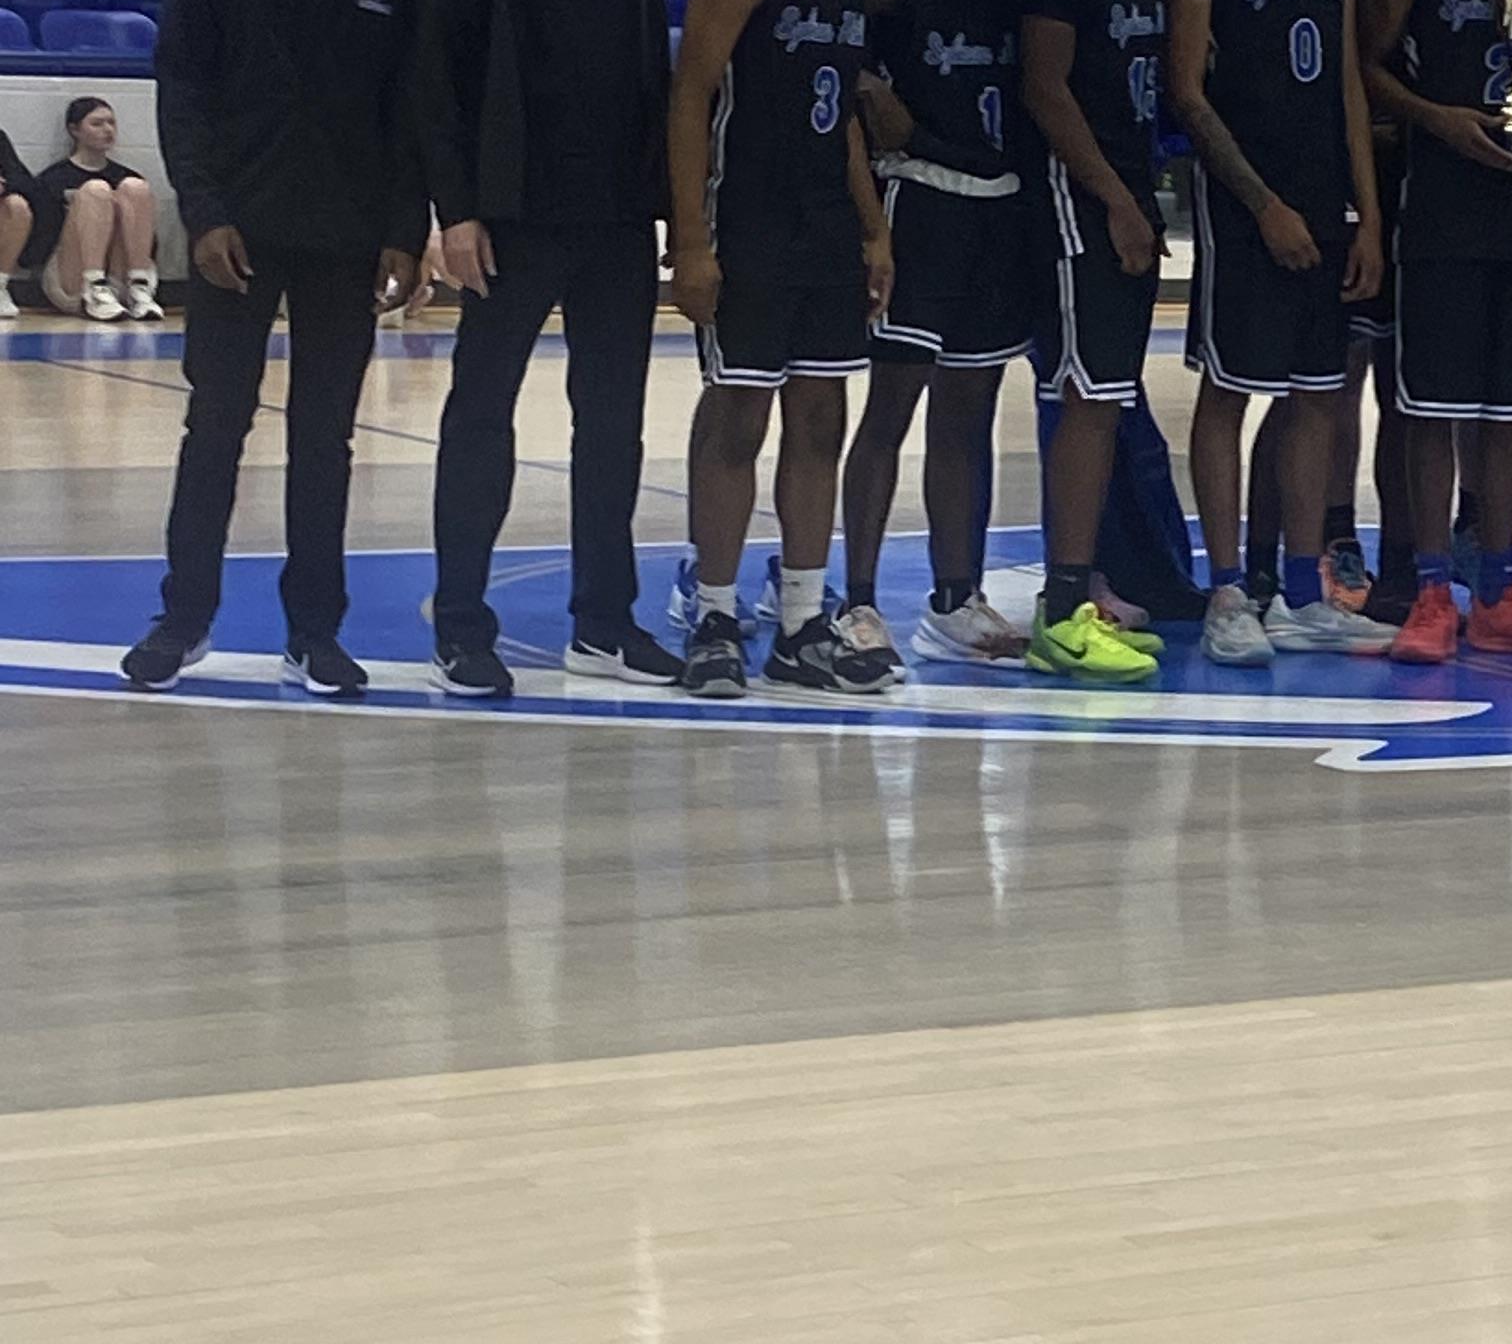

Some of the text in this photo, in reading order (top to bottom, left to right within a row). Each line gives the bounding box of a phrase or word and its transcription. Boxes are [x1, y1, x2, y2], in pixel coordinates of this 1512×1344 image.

[1289, 17, 1324, 83] 0
[810, 65, 841, 134] 3
[978, 85, 1004, 152] 1
